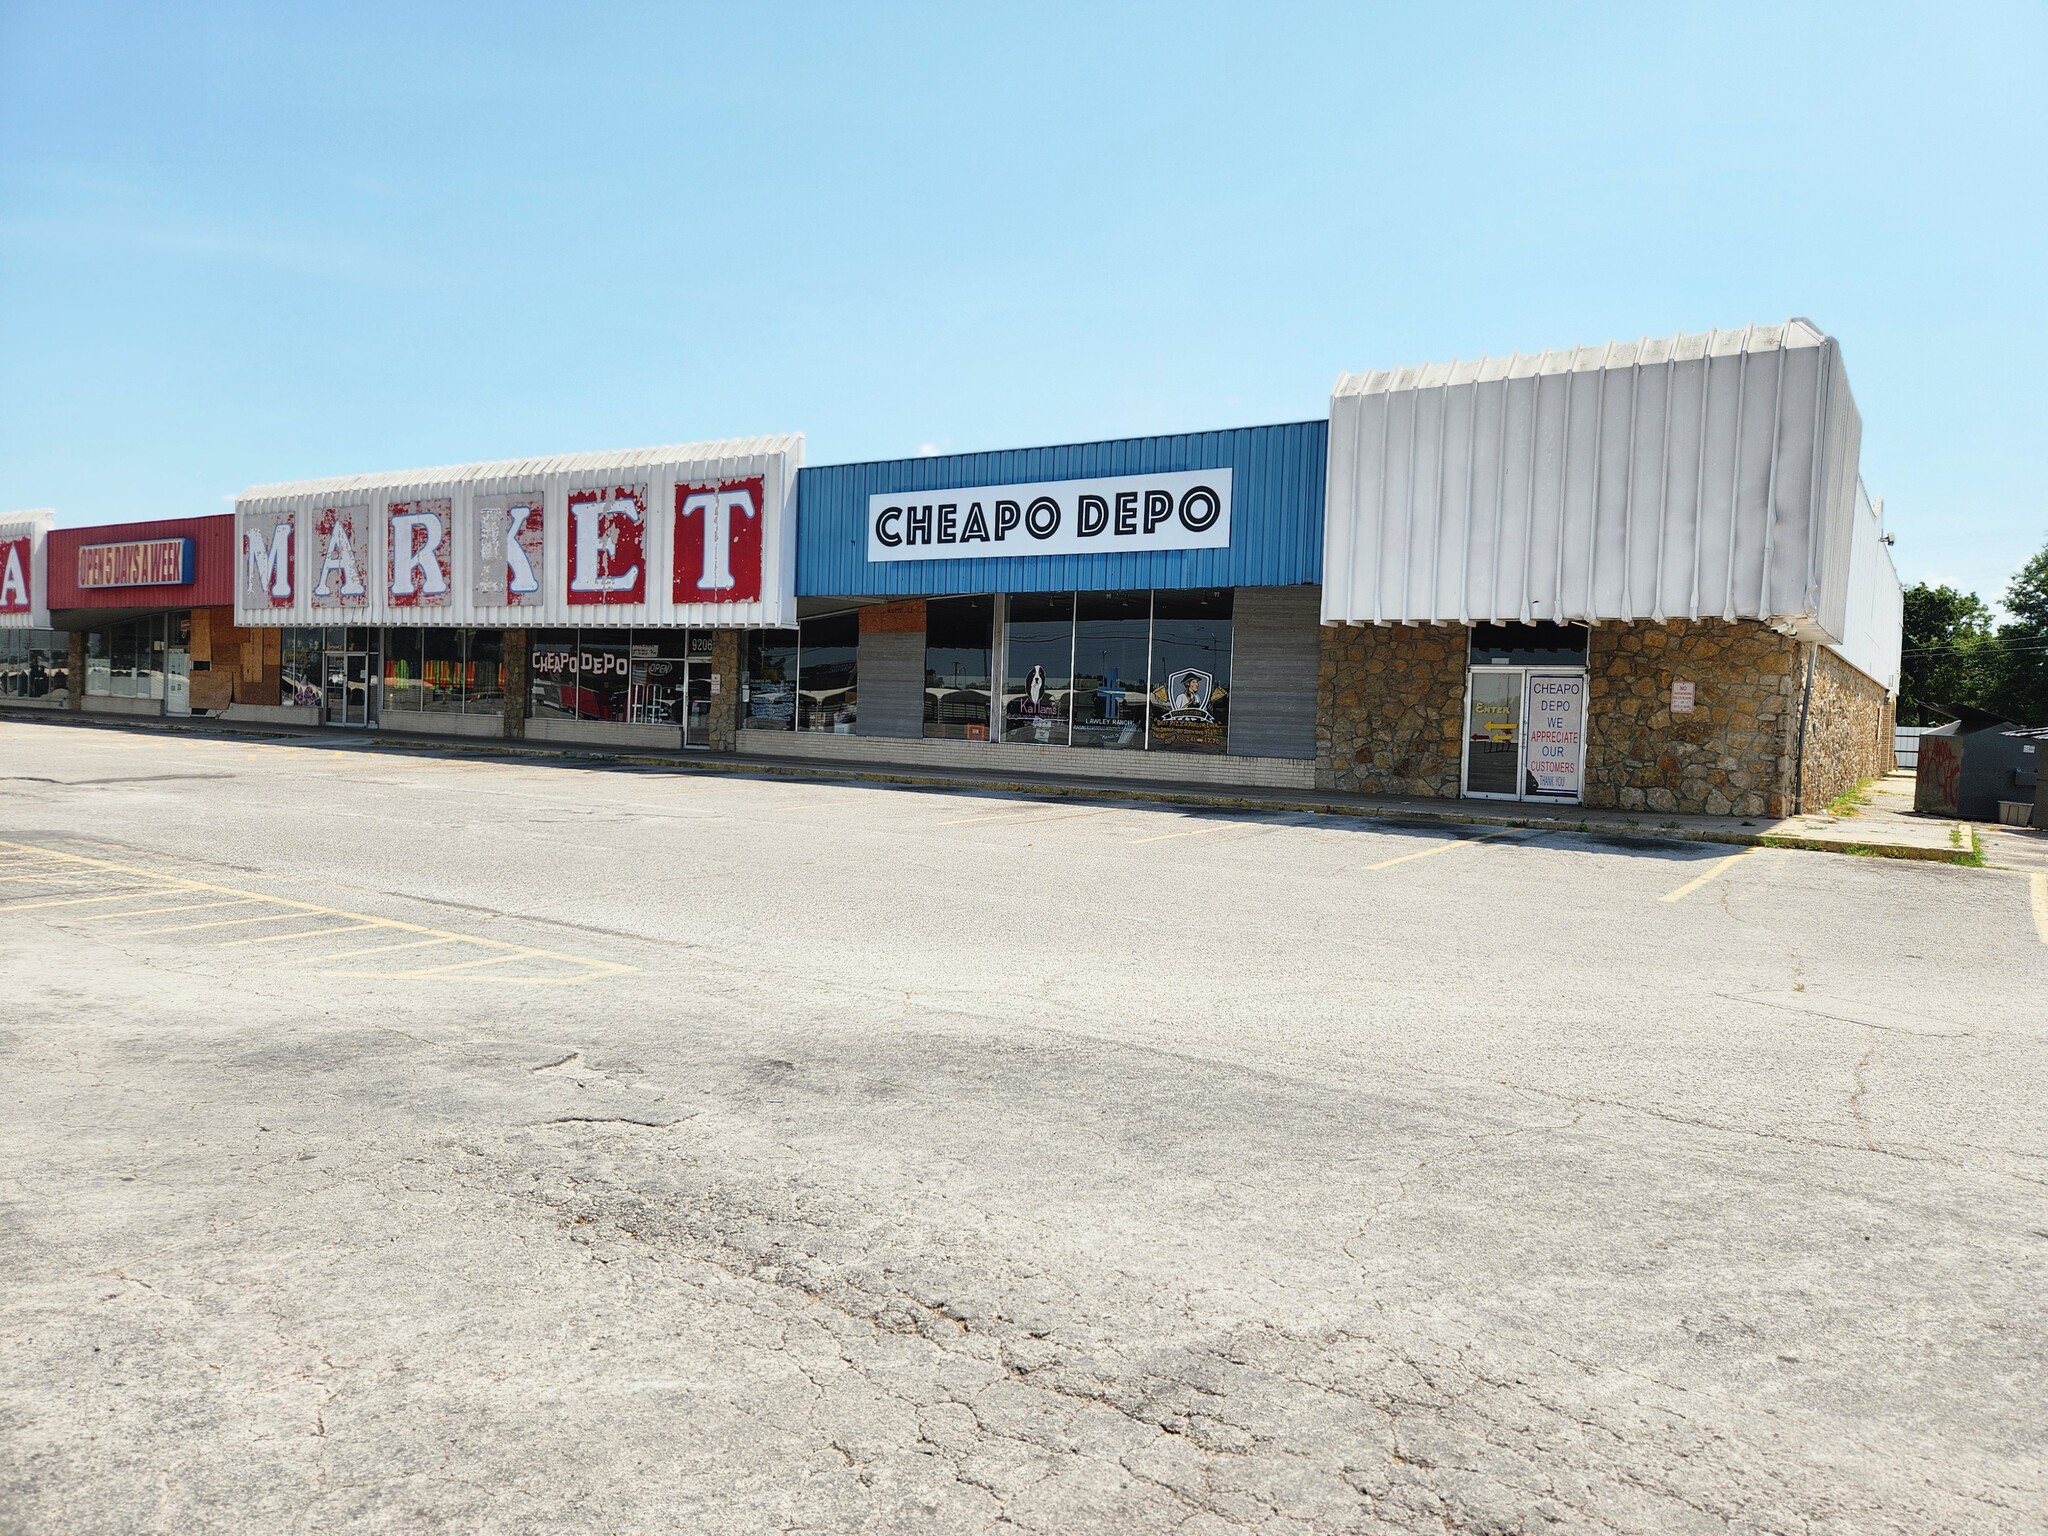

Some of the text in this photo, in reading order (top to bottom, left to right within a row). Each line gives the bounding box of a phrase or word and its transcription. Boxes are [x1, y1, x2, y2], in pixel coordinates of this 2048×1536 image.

[875, 485, 1221, 547] CHEAPO DEPO
[245, 488, 757, 599] MARKET
[80, 541, 181, 585] OPEN 5 DAYS A WEEK
[692, 638, 713, 651] 9206
[532, 651, 578, 673] CHEAPO
[580, 652, 628, 675] DEPO
[650, 664, 670, 674] OPEN
[1533, 683, 1580, 695] CHEAPO
[1541, 700, 1570, 712] DEPO
[1547, 717, 1563, 728] WE
[1531, 730, 1578, 744] APPRECIATE
[1542, 746, 1564, 757] OUR
[1530, 761, 1575, 774] CUSTOMERS
[1539, 775, 1565, 787] THANK YOU
